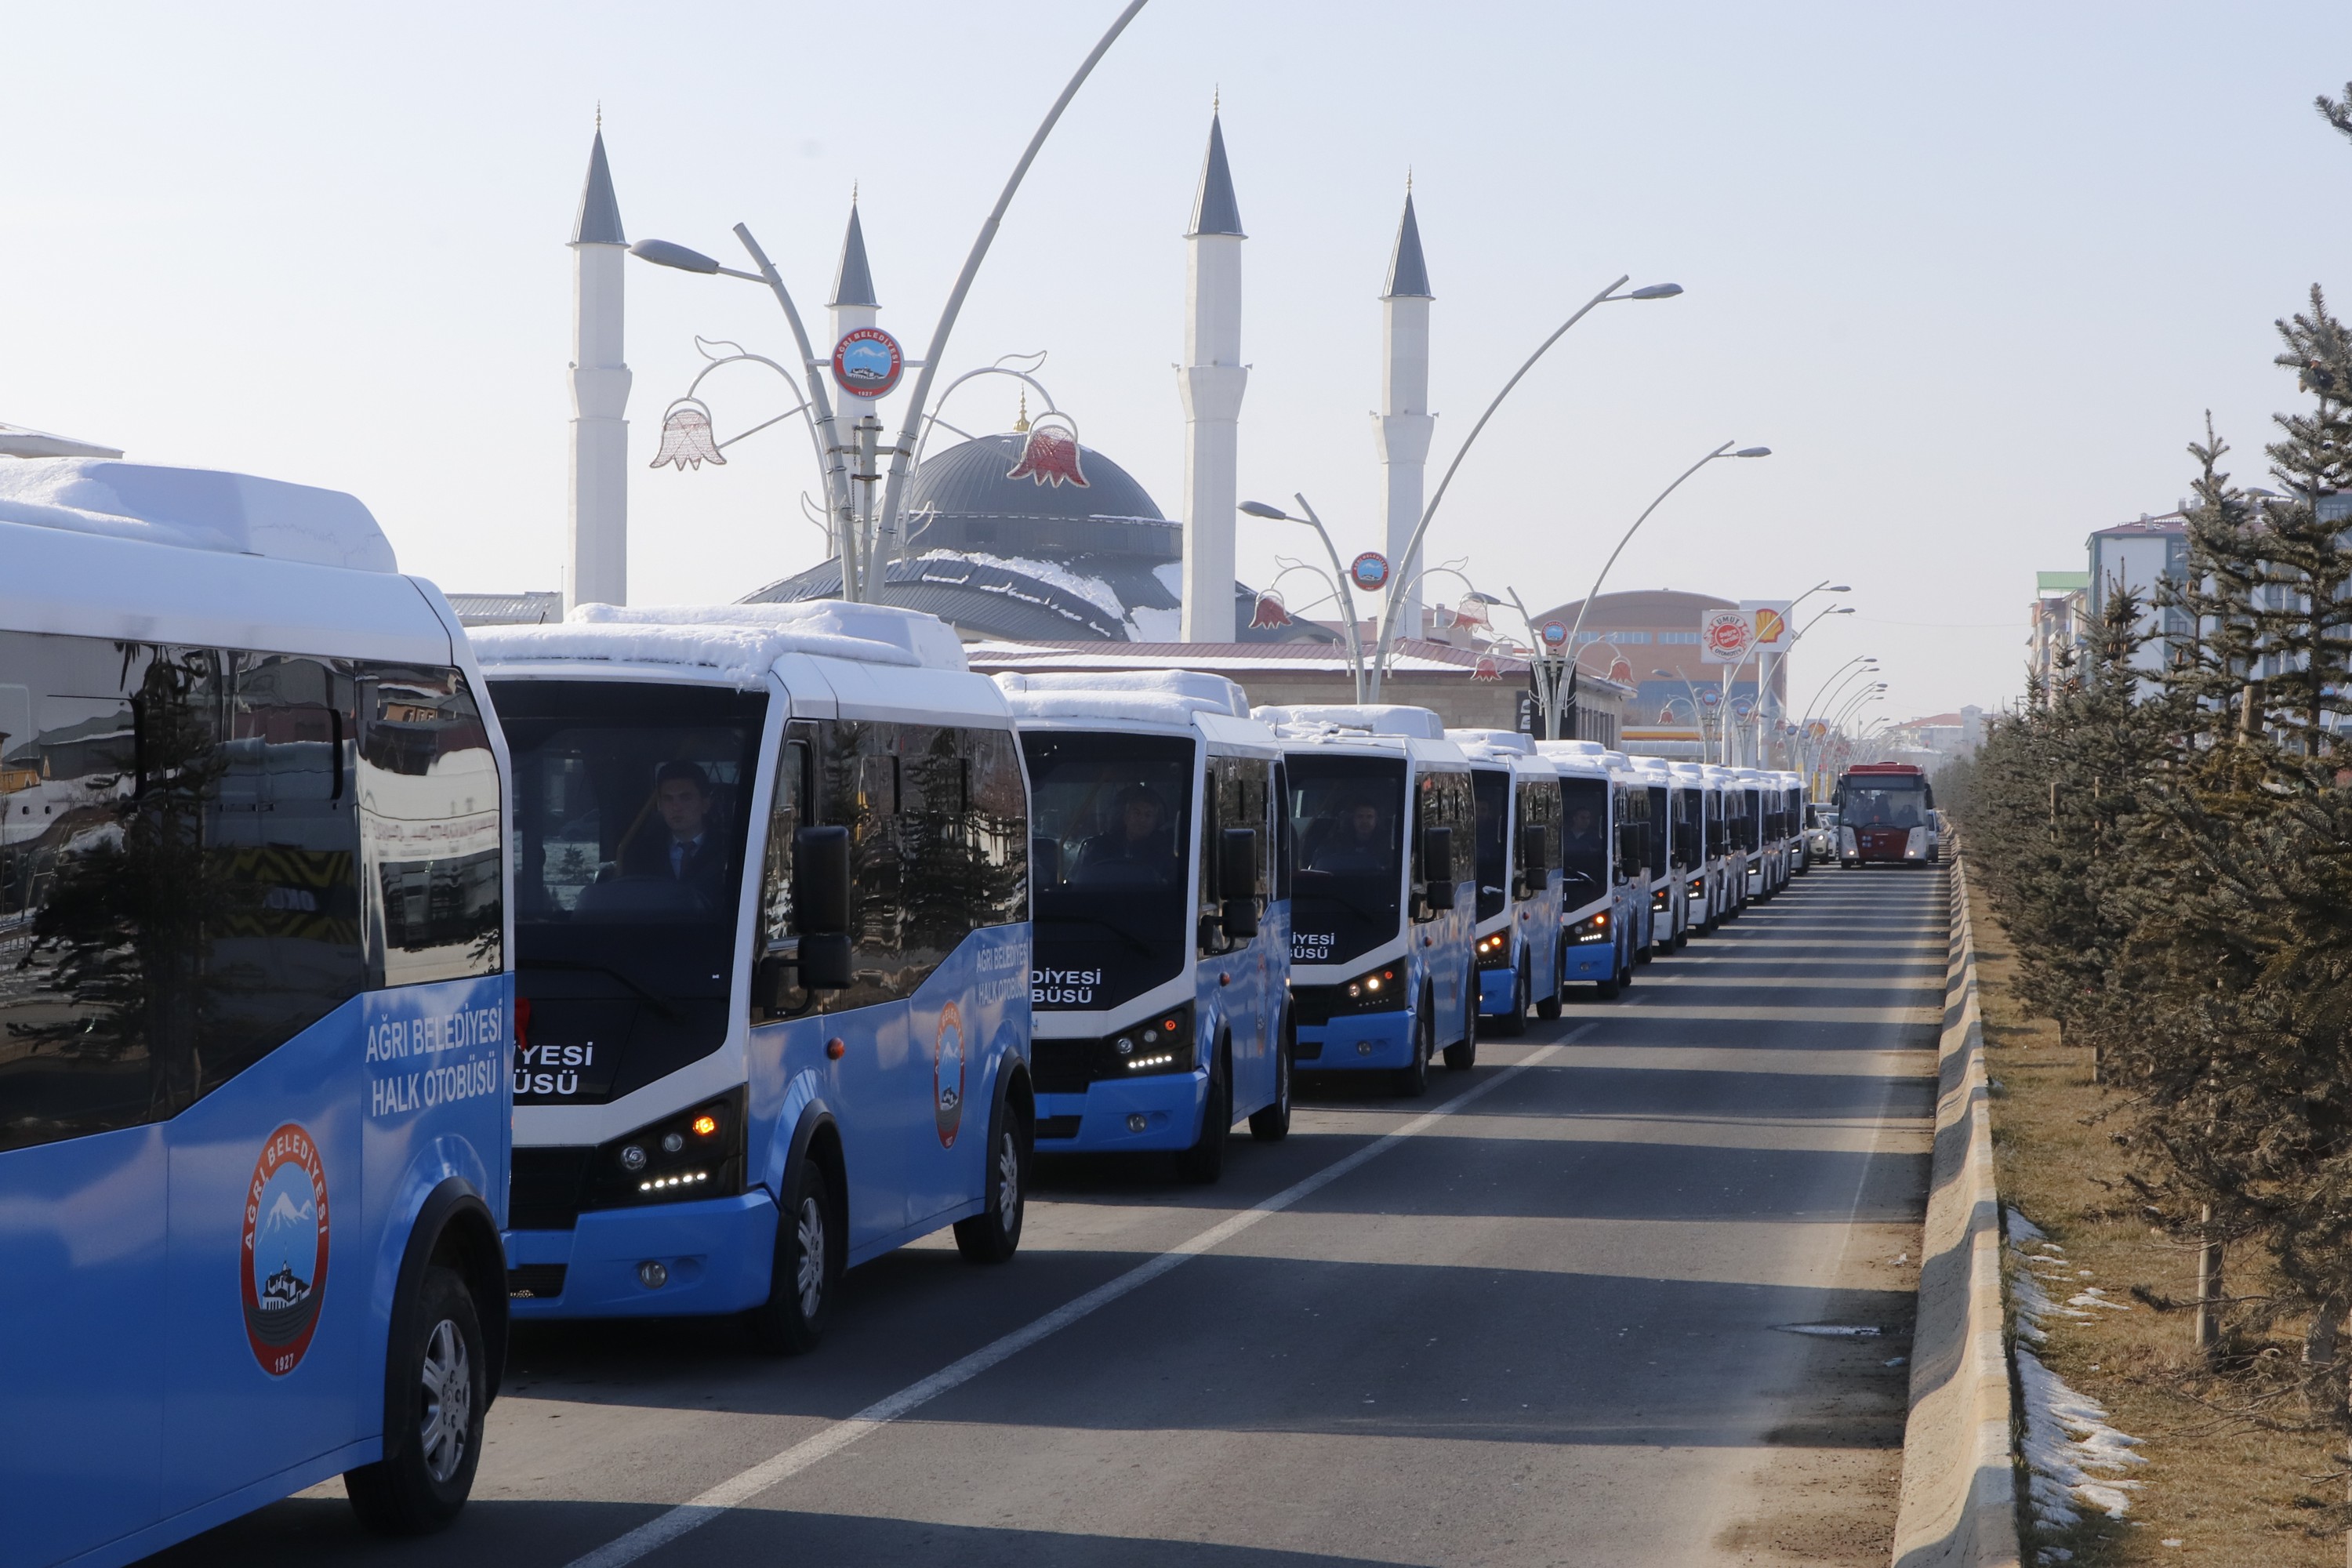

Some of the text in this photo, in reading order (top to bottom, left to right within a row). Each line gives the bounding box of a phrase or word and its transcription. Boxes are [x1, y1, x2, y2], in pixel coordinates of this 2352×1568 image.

[1032, 967, 1101, 985] DİYESİ
[978, 979, 997, 1005] HALK
[1032, 986, 1092, 1004] BÜSÜ
[365, 998, 503, 1063] AĞRI BELEDİYESİ
[514, 1040, 593, 1065] YESİ
[372, 1051, 496, 1116] HALK OTOBÜSÜ
[245, 1134, 328, 1250] AĞRI BELEDİYESİ
[275, 1352, 294, 1373] 1927
